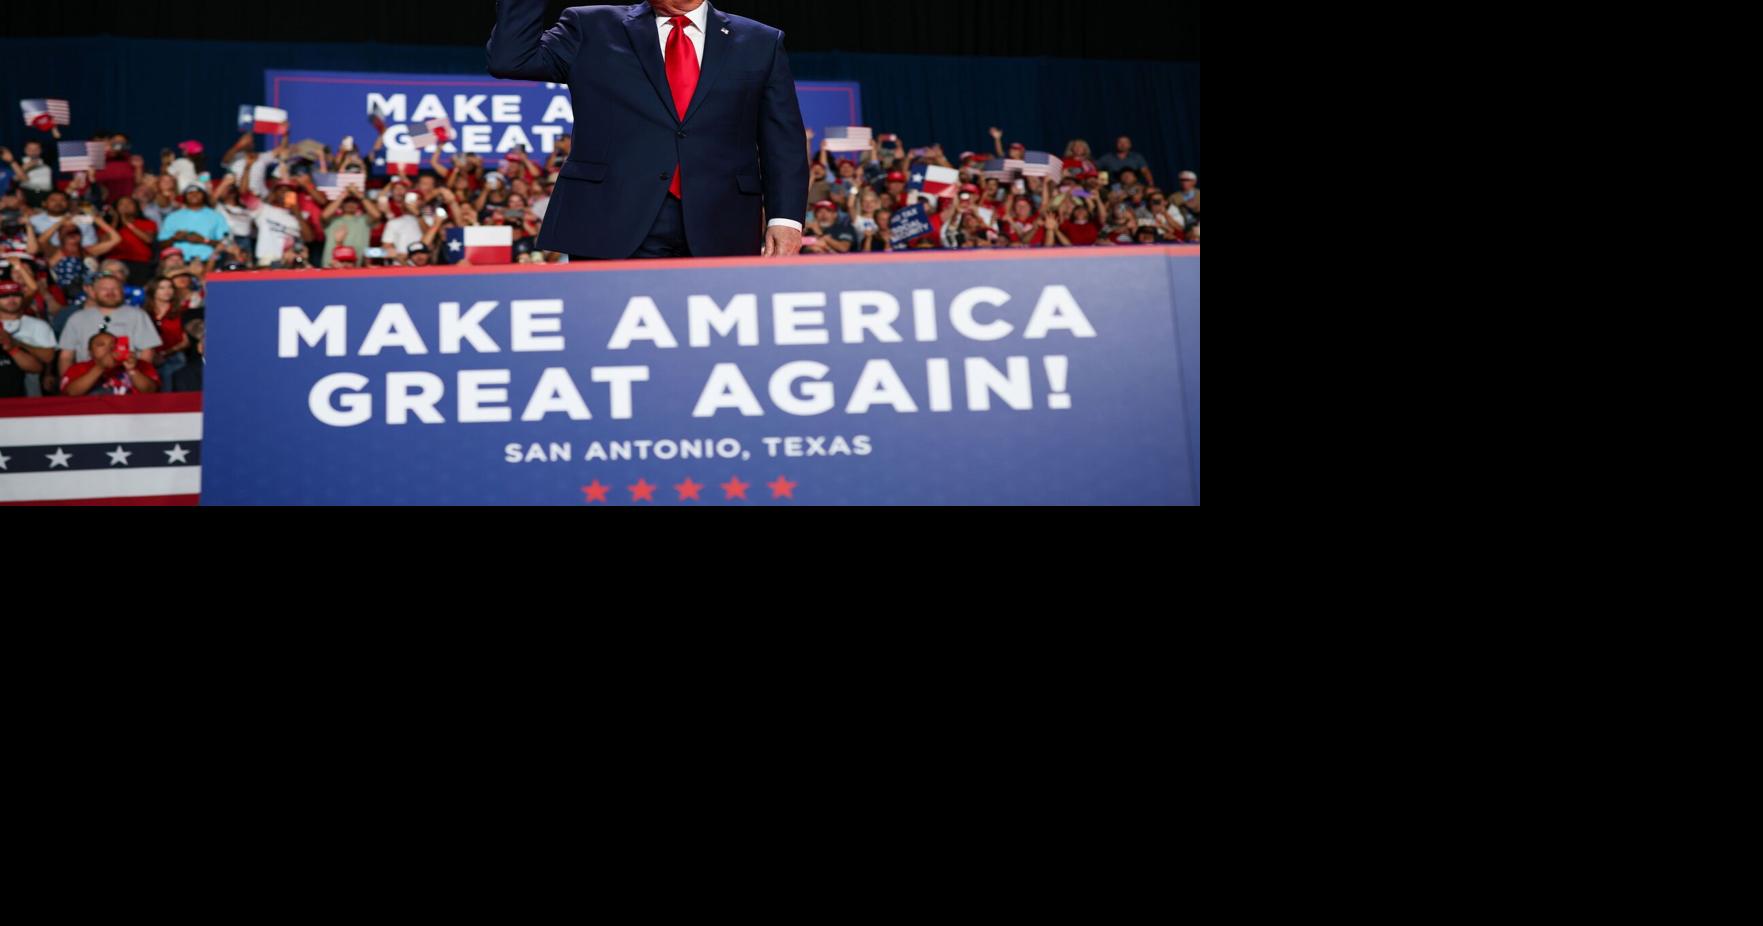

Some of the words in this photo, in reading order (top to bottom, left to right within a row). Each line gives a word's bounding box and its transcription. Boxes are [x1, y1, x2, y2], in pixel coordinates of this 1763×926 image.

[366, 92, 523, 123] MAKE
[278, 298, 565, 358] MAKE
[607, 283, 1098, 350] AMERICA
[308, 365, 650, 427] GREAT
[692, 354, 1073, 418] AGAIN!
[504, 442, 571, 463] SAN
[585, 438, 750, 462] ANTONIO,
[762, 435, 873, 457] TEXAS
